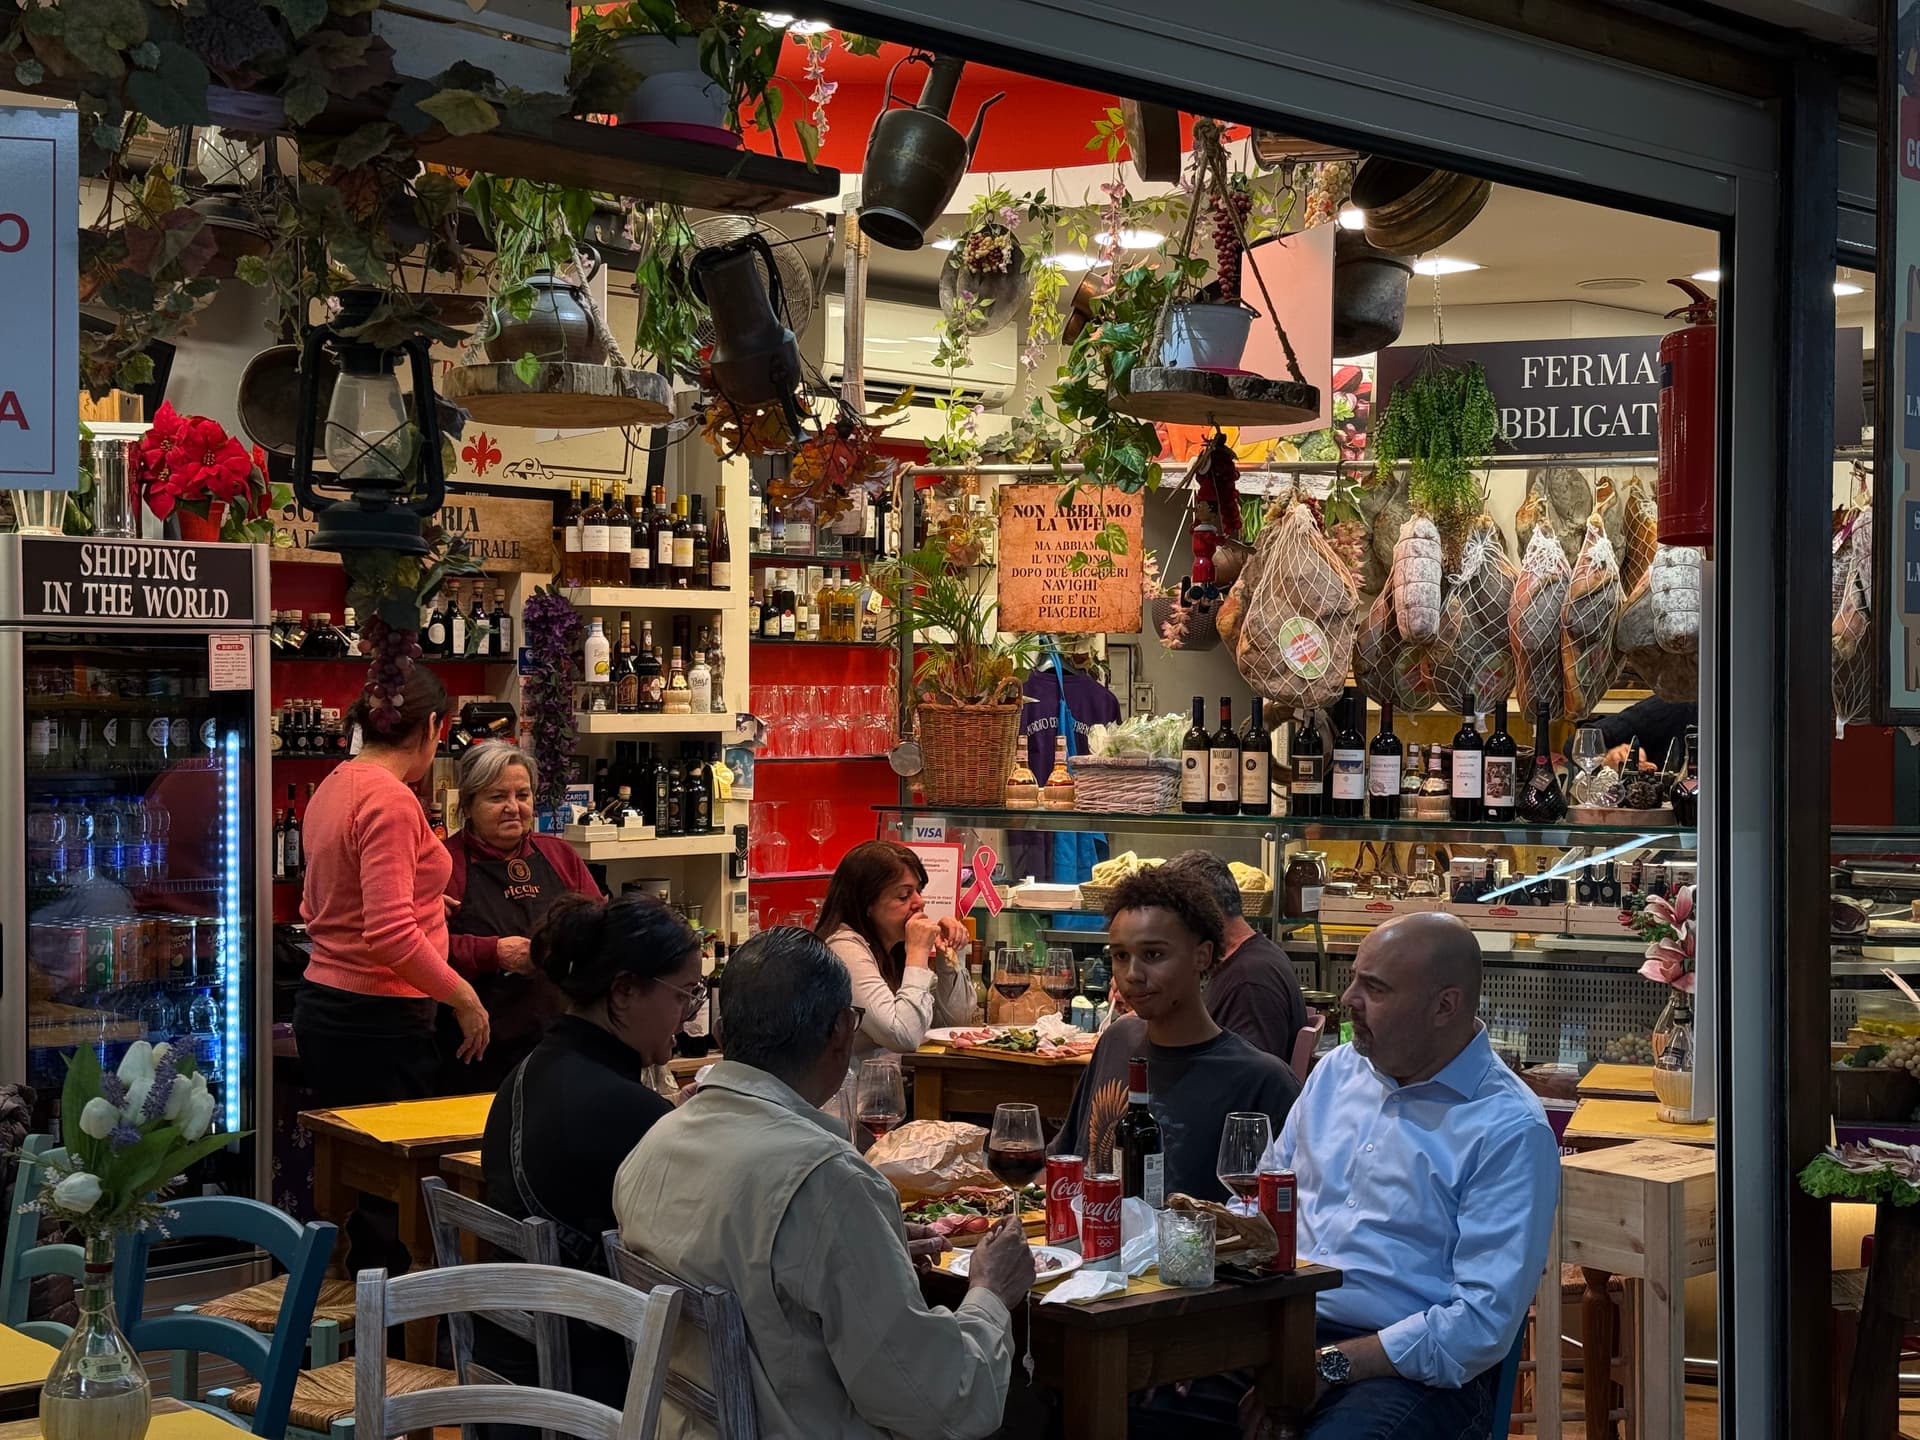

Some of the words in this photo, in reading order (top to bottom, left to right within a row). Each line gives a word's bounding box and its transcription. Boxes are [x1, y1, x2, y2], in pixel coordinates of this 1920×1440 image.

[0, 213, 30, 253] O
[1520, 351, 1661, 389] FERMA
[0, 390, 30, 430] A
[1906, 394, 1920, 417] LA
[1498, 402, 1659, 440] BBLIGAT
[1013, 504, 1046, 518] NON
[1055, 504, 1132, 518] ABBIAMO
[1036, 518, 1057, 531] LA
[1066, 518, 1106, 531] WI-FI
[1034, 541, 1051, 551] MA
[1054, 541, 1099, 551] ABBIAM
[79, 543, 198, 582] SHIPPING
[1031, 554, 1042, 564] IL
[1011, 567, 1042, 578] DOPO
[1046, 567, 1068, 578] DUE
[1906, 561, 1920, 583] LA
[1041, 579, 1098, 591] NAVIGHI
[42, 580, 73, 614] IN
[81, 582, 134, 616] THE
[141, 585, 230, 619] WORLD
[1041, 594, 1064, 605] CHE
[1068, 592, 1079, 605] E'
[1081, 594, 1098, 605] UN
[1038, 606, 1102, 618] PIACERE!
[564, 793, 588, 802] CARDS
[546, 823, 566, 831] ACCE
[916, 827, 943, 838] VISA
[1050, 1176, 1084, 1201] Coca
